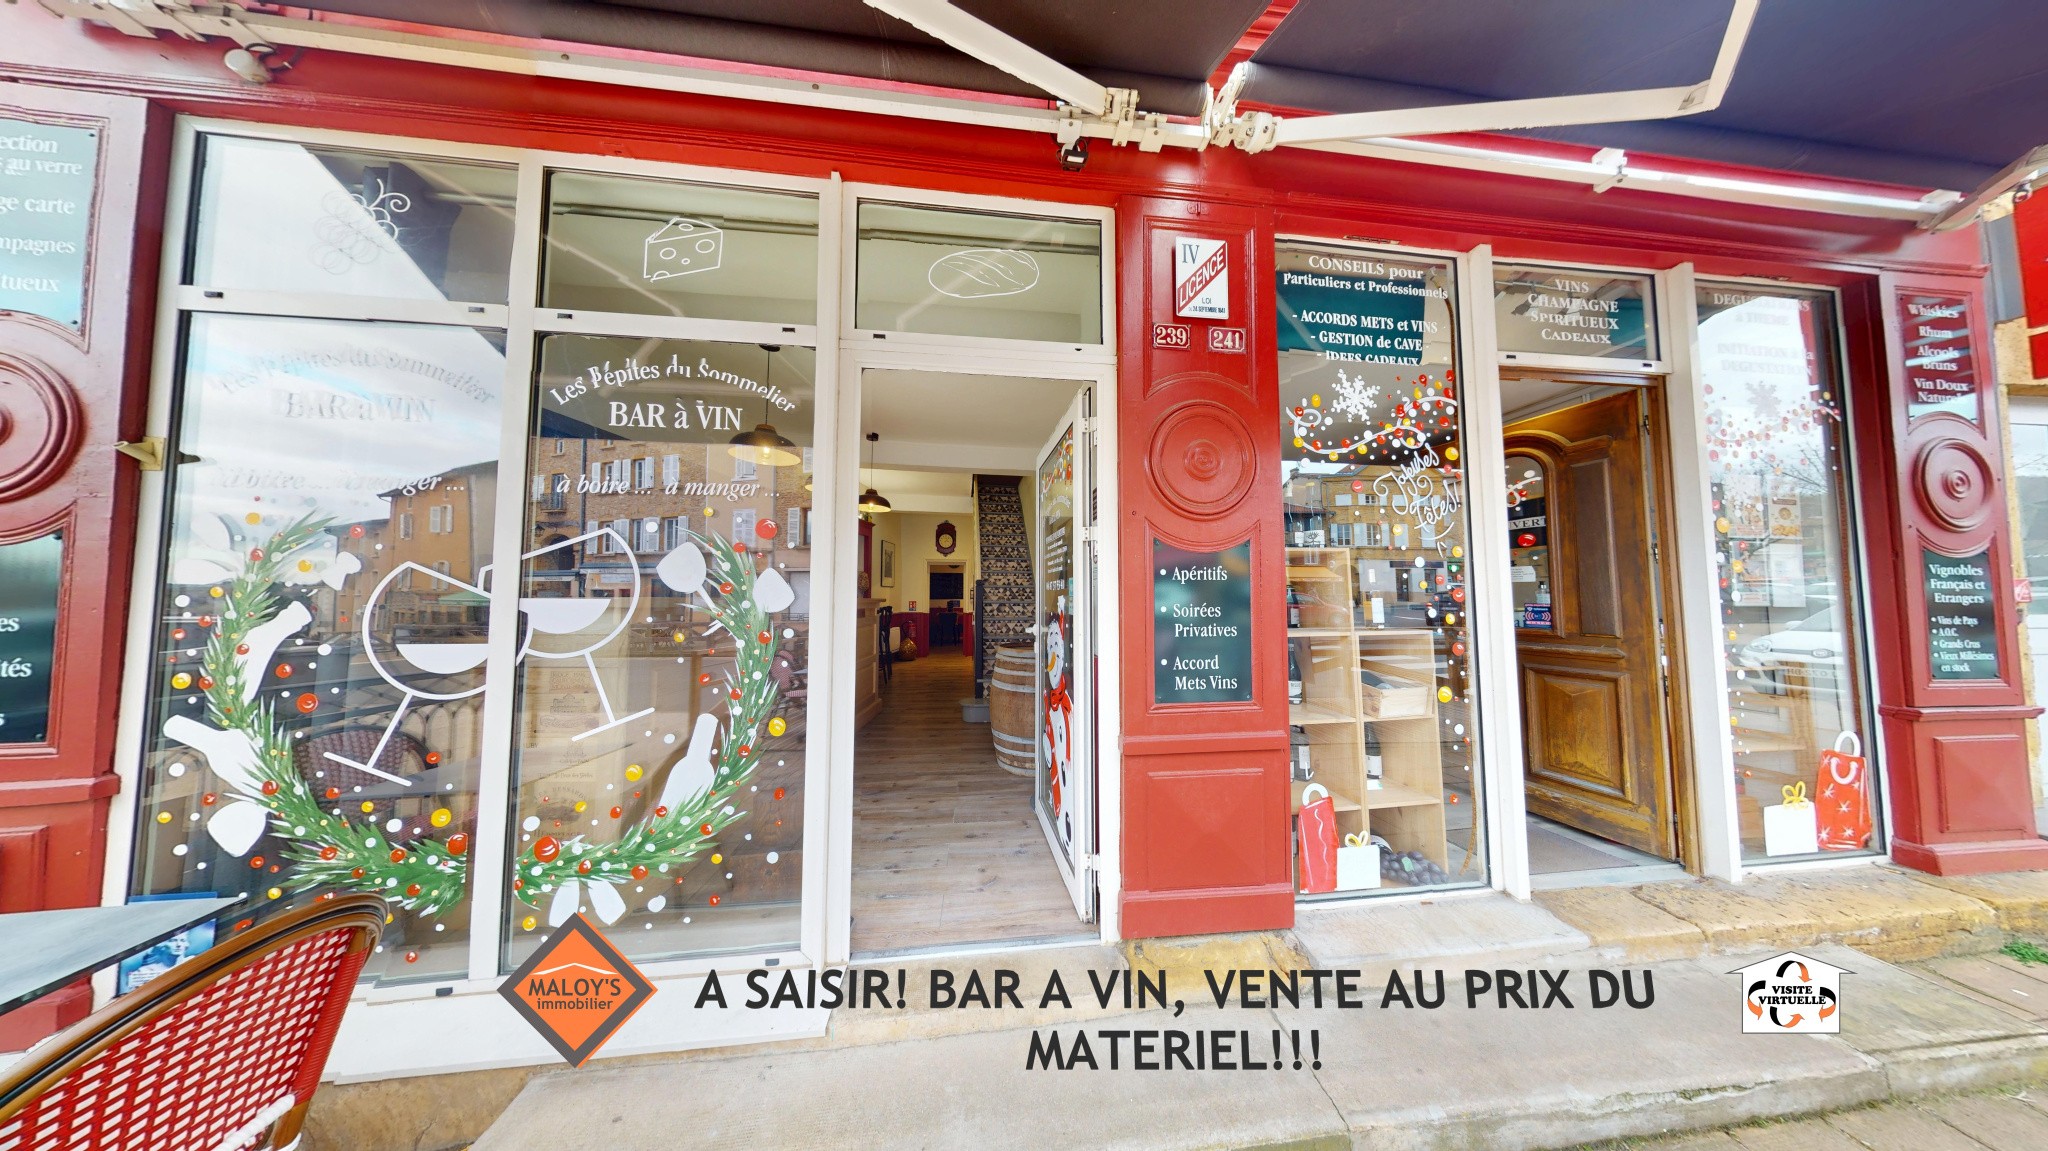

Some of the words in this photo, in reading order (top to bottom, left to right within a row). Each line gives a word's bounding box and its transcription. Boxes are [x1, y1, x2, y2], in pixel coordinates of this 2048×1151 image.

[35, 159, 83, 176] verre
[25, 198, 76, 215] carte
[1182, 243, 1200, 264] IV
[1308, 255, 1384, 276] CONSEILS
[1389, 267, 1424, 280] pour
[1179, 247, 1225, 309] LICENCE
[1283, 272, 1352, 290] Particuliers
[1354, 280, 1366, 291] et
[1368, 280, 1448, 300] Professionnels
[1555, 278, 1590, 294] VINS
[1201, 297, 1212, 305] LOI
[1907, 304, 1960, 318] Whiskies
[1301, 309, 1357, 327] ACCORDS
[1360, 315, 1394, 330] METS
[1397, 319, 1409, 332] et
[1411, 319, 1438, 334] VINS
[1156, 326, 1187, 345] 239
[1213, 330, 1241, 349] 241
[1918, 325, 1953, 338] Rhum
[1319, 330, 1373, 347] GESTION
[1376, 335, 1391, 349] de
[1394, 337, 1423, 352] CAVE
[1917, 345, 1960, 358] Alcools
[1922, 360, 1958, 371] Bruns
[550, 375, 587, 406] Les
[588, 357, 660, 389] Pépites
[666, 354, 691, 379] du
[698, 357, 796, 414] Sommelier
[1913, 377, 1934, 389] Vin
[1935, 379, 1969, 391] Doux
[609, 401, 667, 429] BAR
[674, 397, 690, 430] à
[696, 400, 744, 431] VIN
[1373, 443, 1439, 515] Joyeuses
[556, 474, 571, 495] à
[577, 474, 630, 495] boire
[665, 476, 679, 496] à
[684, 480, 760, 502] manger
[1172, 566, 1228, 584] Apéritifs
[1928, 564, 1984, 578] Vignobles
[1930, 579, 1973, 592] Français
[1974, 581, 1986, 590] et
[1934, 592, 1985, 606] Etrangers
[1173, 602, 1221, 618] Soirées
[1937, 616, 1952, 625] Vins
[1953, 616, 1961, 625] de
[1174, 623, 1238, 637] Privatives
[1939, 639, 1963, 649] Grands
[1173, 655, 1219, 671] Accord
[1952, 663, 1971, 672] stock
[1175, 676, 1206, 690] Mets
[1209, 675, 1238, 690] Vins
